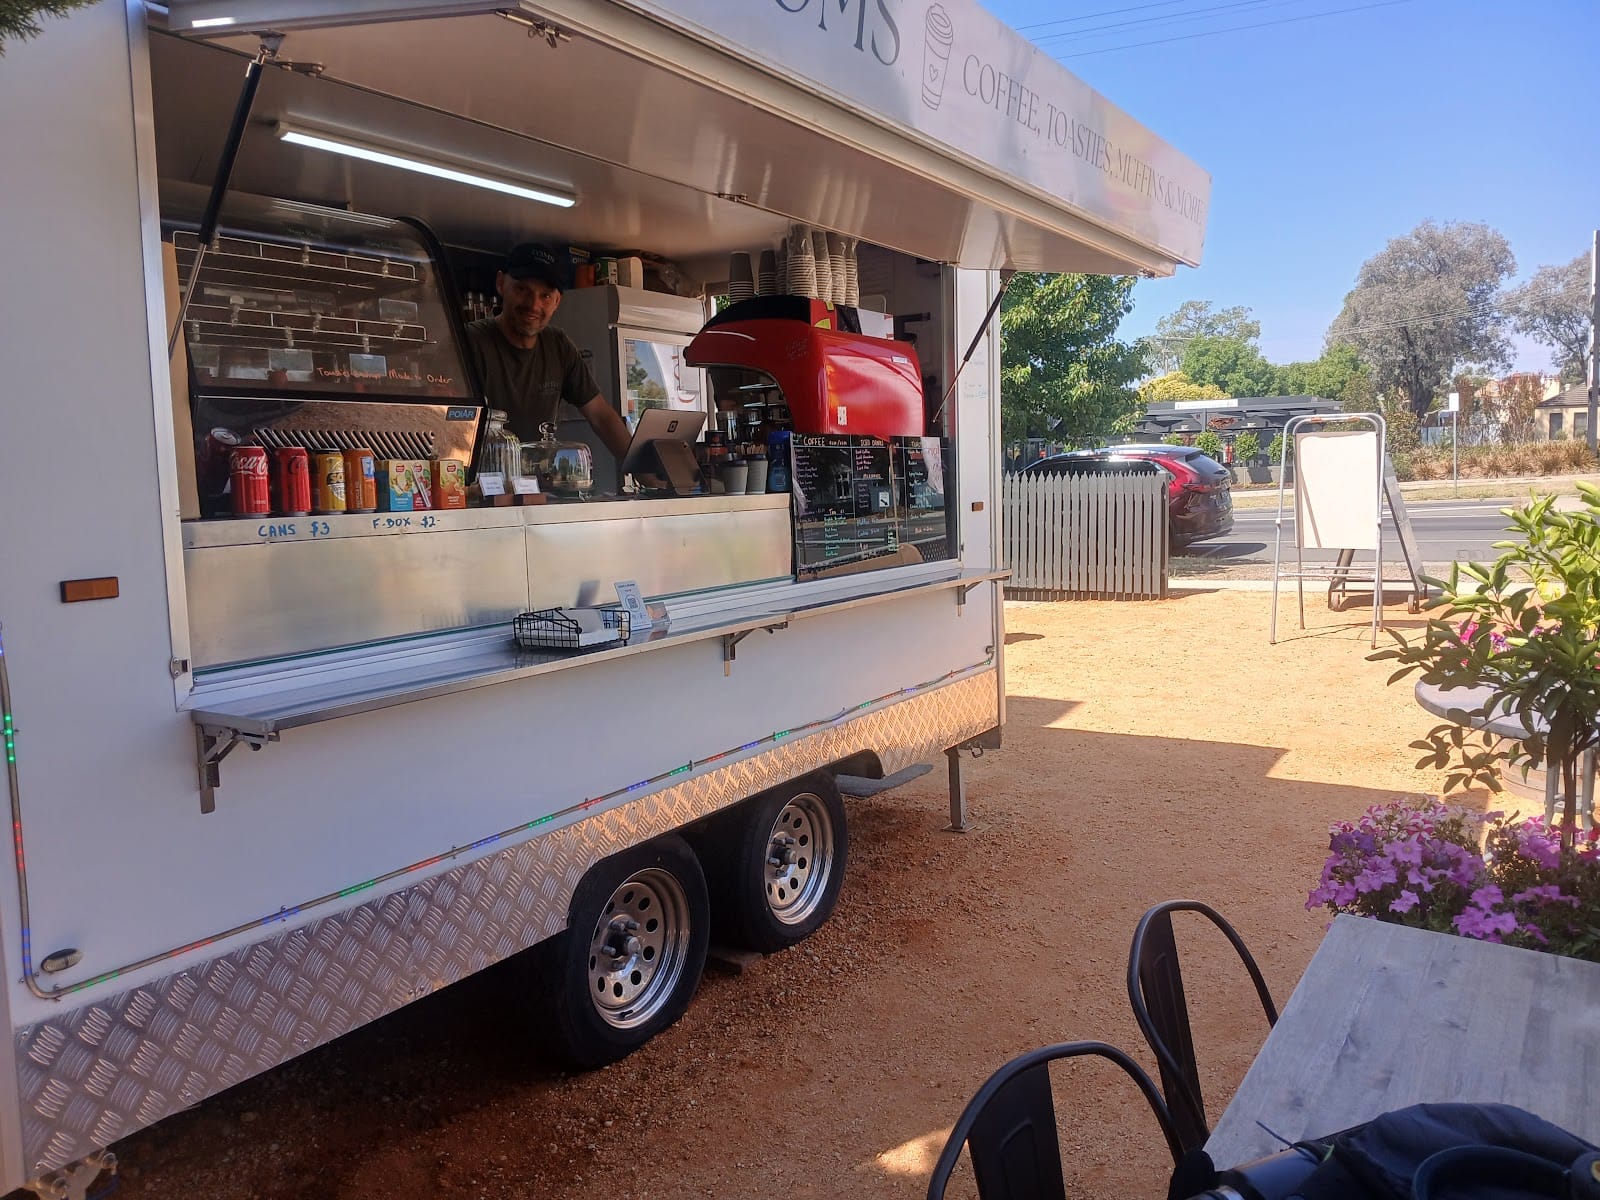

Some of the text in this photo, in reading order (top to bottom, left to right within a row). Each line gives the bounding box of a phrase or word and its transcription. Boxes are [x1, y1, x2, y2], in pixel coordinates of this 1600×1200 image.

[963, 54, 1040, 137] COFFEE,
[1046, 102, 1113, 178] TOASTIES,
[1115, 148, 1164, 202] MUFFINS
[1164, 181, 1173, 209] &
[426, 374, 453, 384] Order
[258, 521, 330, 537] CANS $3
